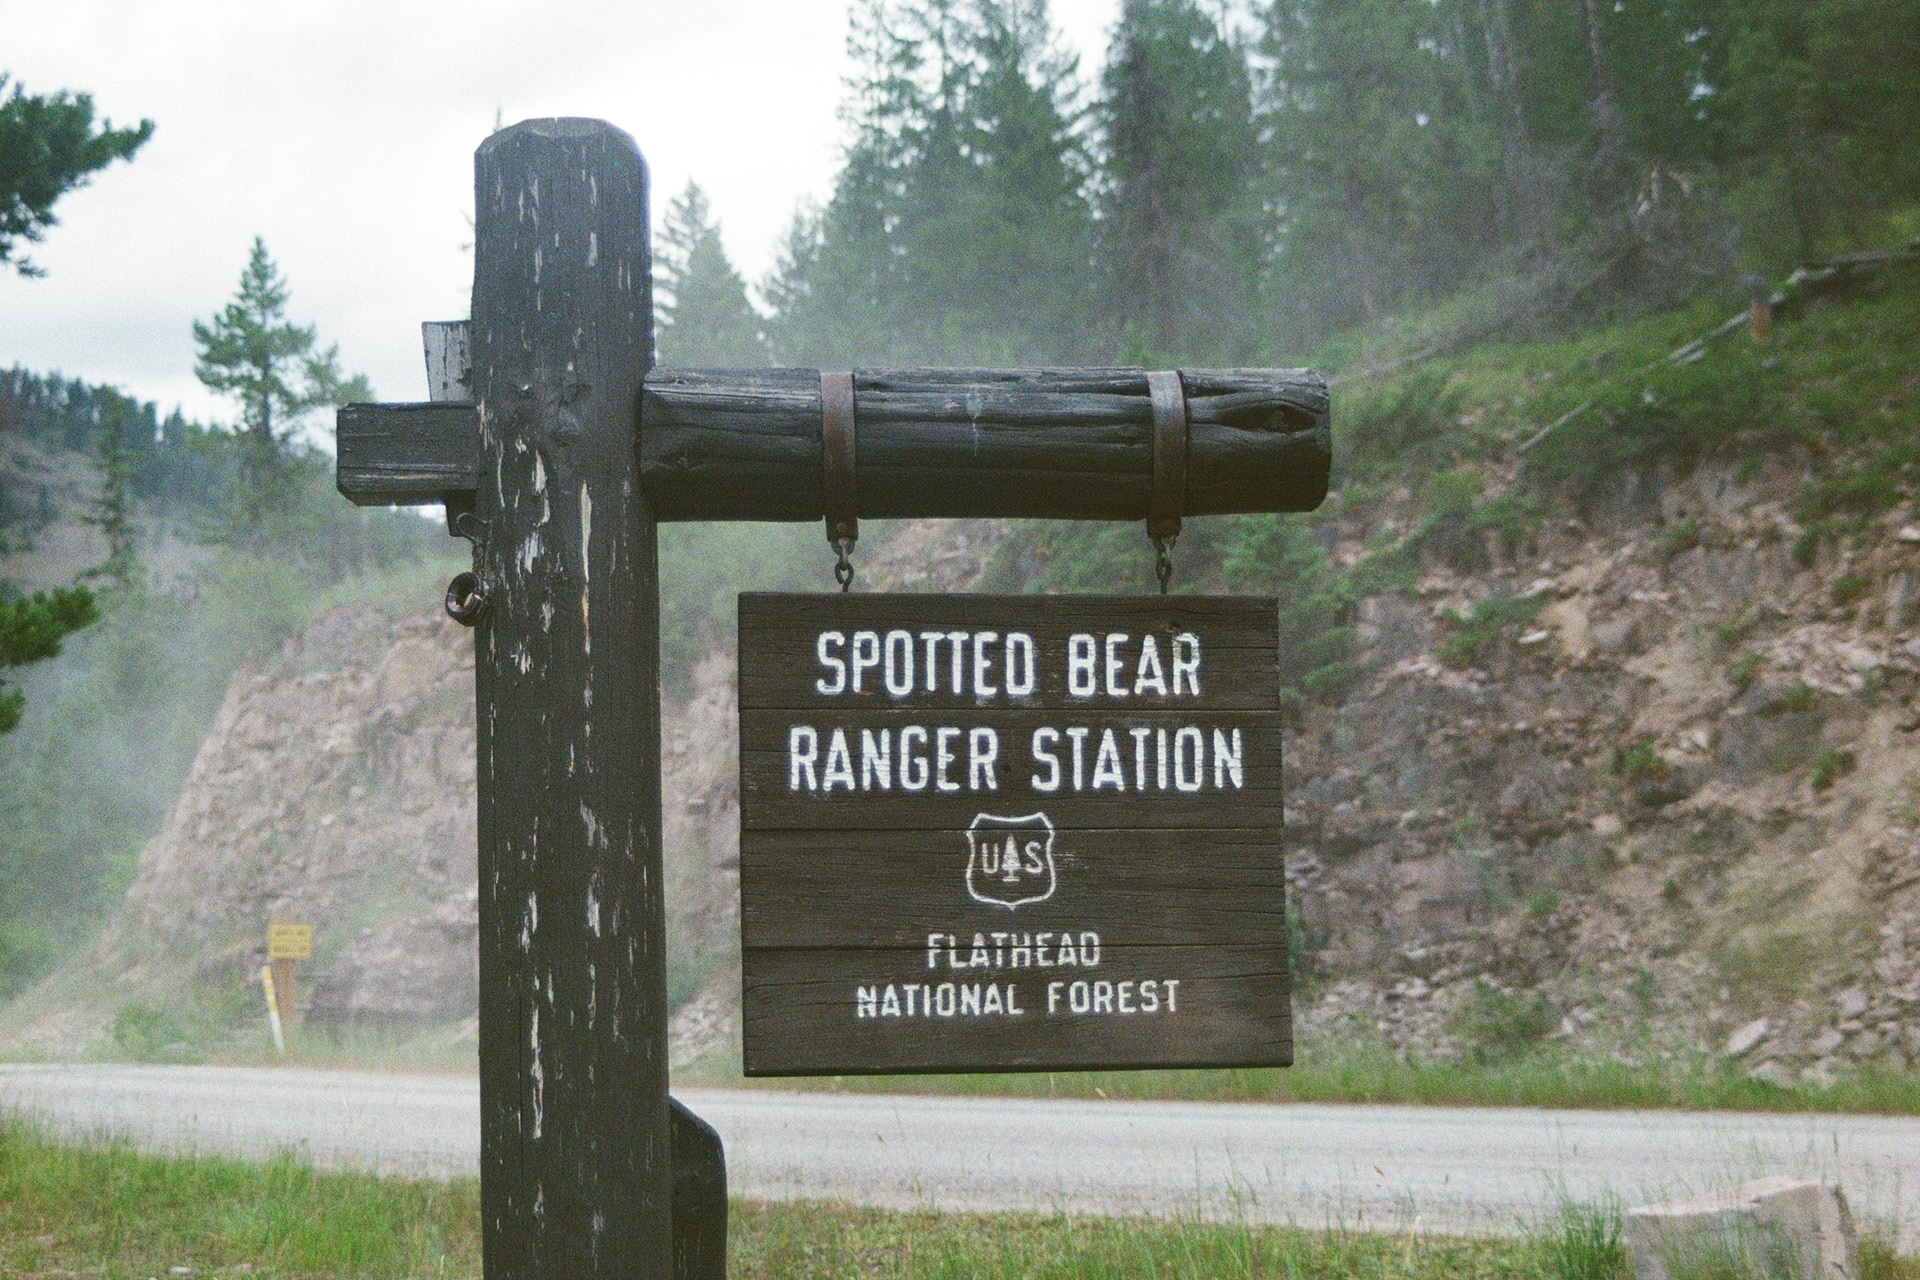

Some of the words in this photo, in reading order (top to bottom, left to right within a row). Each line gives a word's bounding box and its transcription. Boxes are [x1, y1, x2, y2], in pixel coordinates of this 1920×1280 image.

[815, 629, 1035, 697] SPOTTED
[1067, 632, 1202, 699] BEAR
[788, 724, 999, 793] RANGER
[1031, 725, 1244, 793] STATION
[927, 931, 1101, 968] FLATHEAD
[855, 982, 1025, 1019] NATIONAL
[1047, 979, 1180, 1017] FOREST
